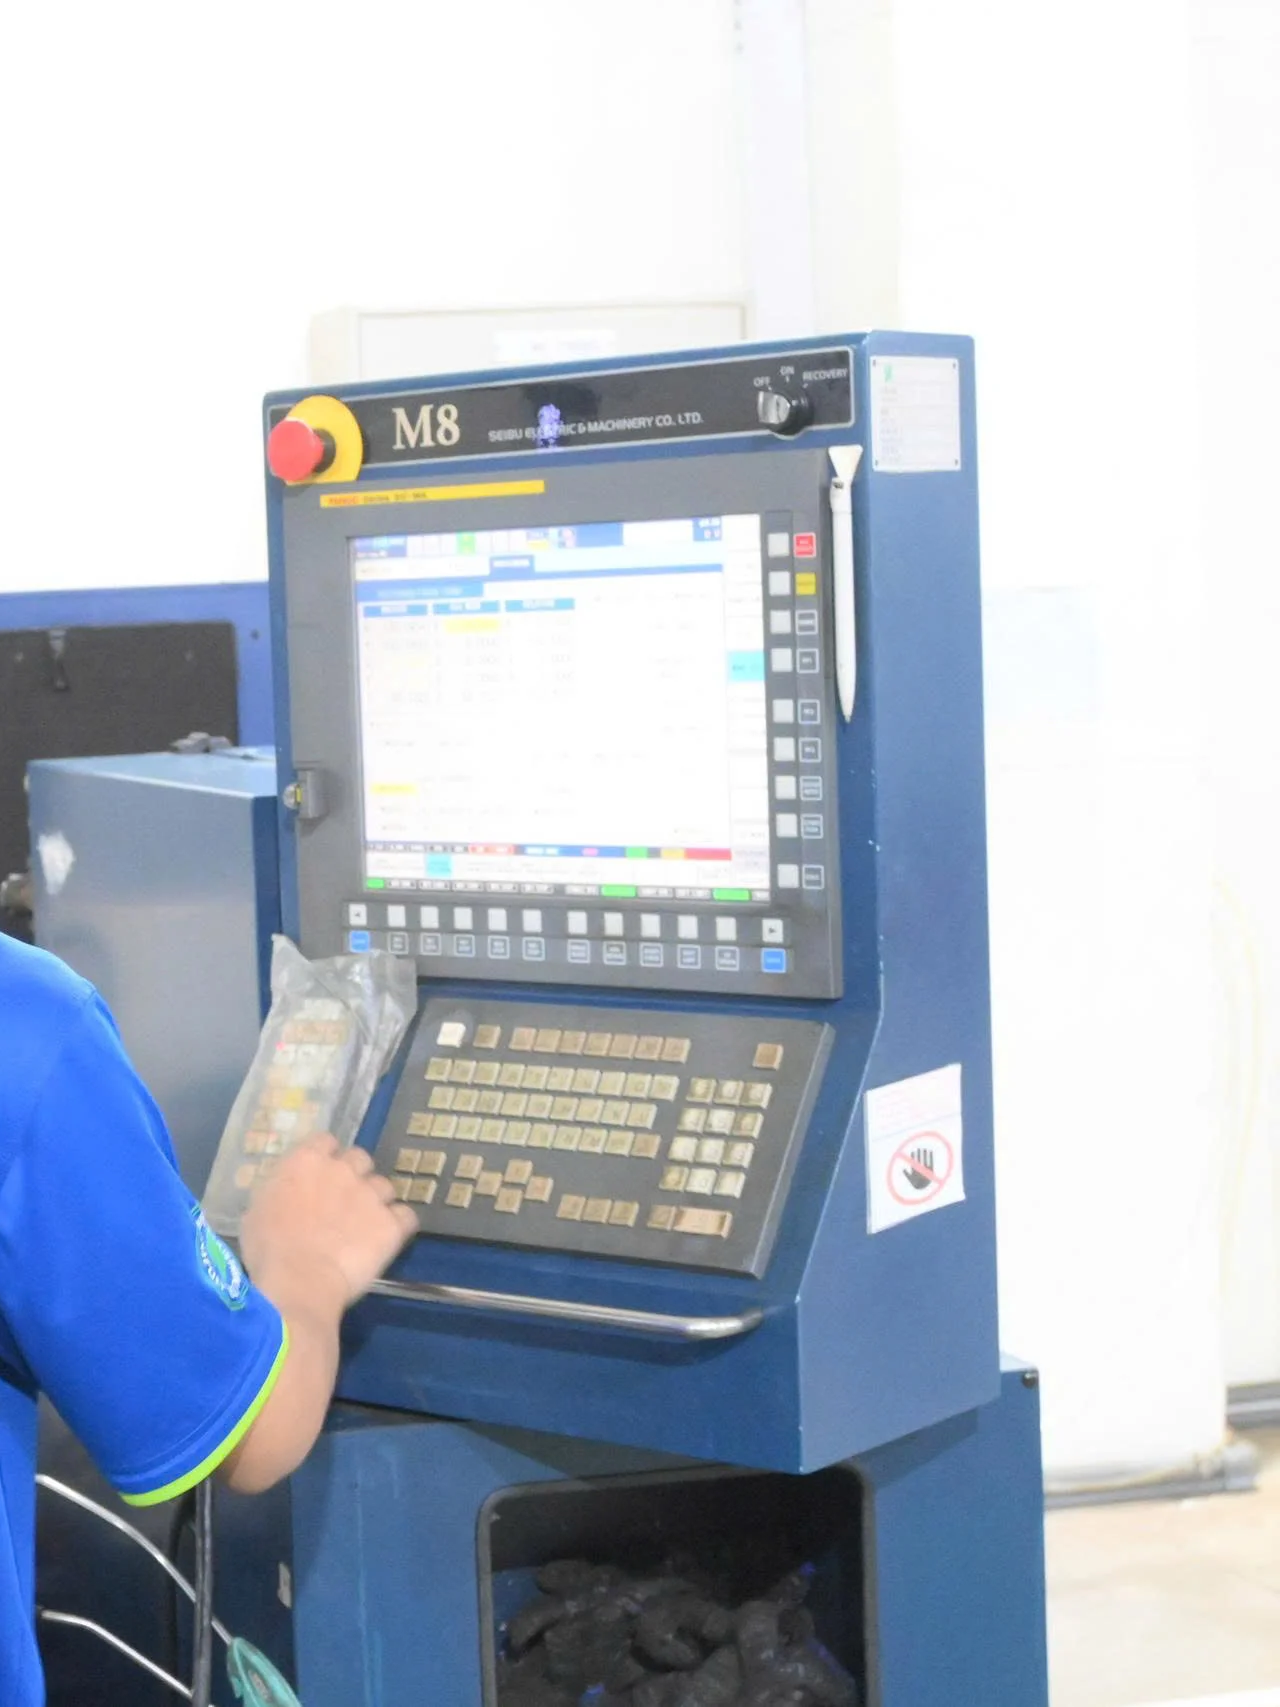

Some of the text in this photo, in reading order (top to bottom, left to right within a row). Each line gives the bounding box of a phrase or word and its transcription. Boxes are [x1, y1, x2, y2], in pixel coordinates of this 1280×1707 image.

[780, 366, 795, 376] ON
[802, 367, 848, 381] RECOVERY
[753, 376, 771, 388] OFF
[392, 403, 461, 450] M8
[488, 428, 523, 442] SEIBU
[524, 423, 578, 440] ELRIC
[587, 416, 654, 433] MACHINERY
[655, 414, 676, 428] CO.
[678, 411, 704, 425] LTD.
